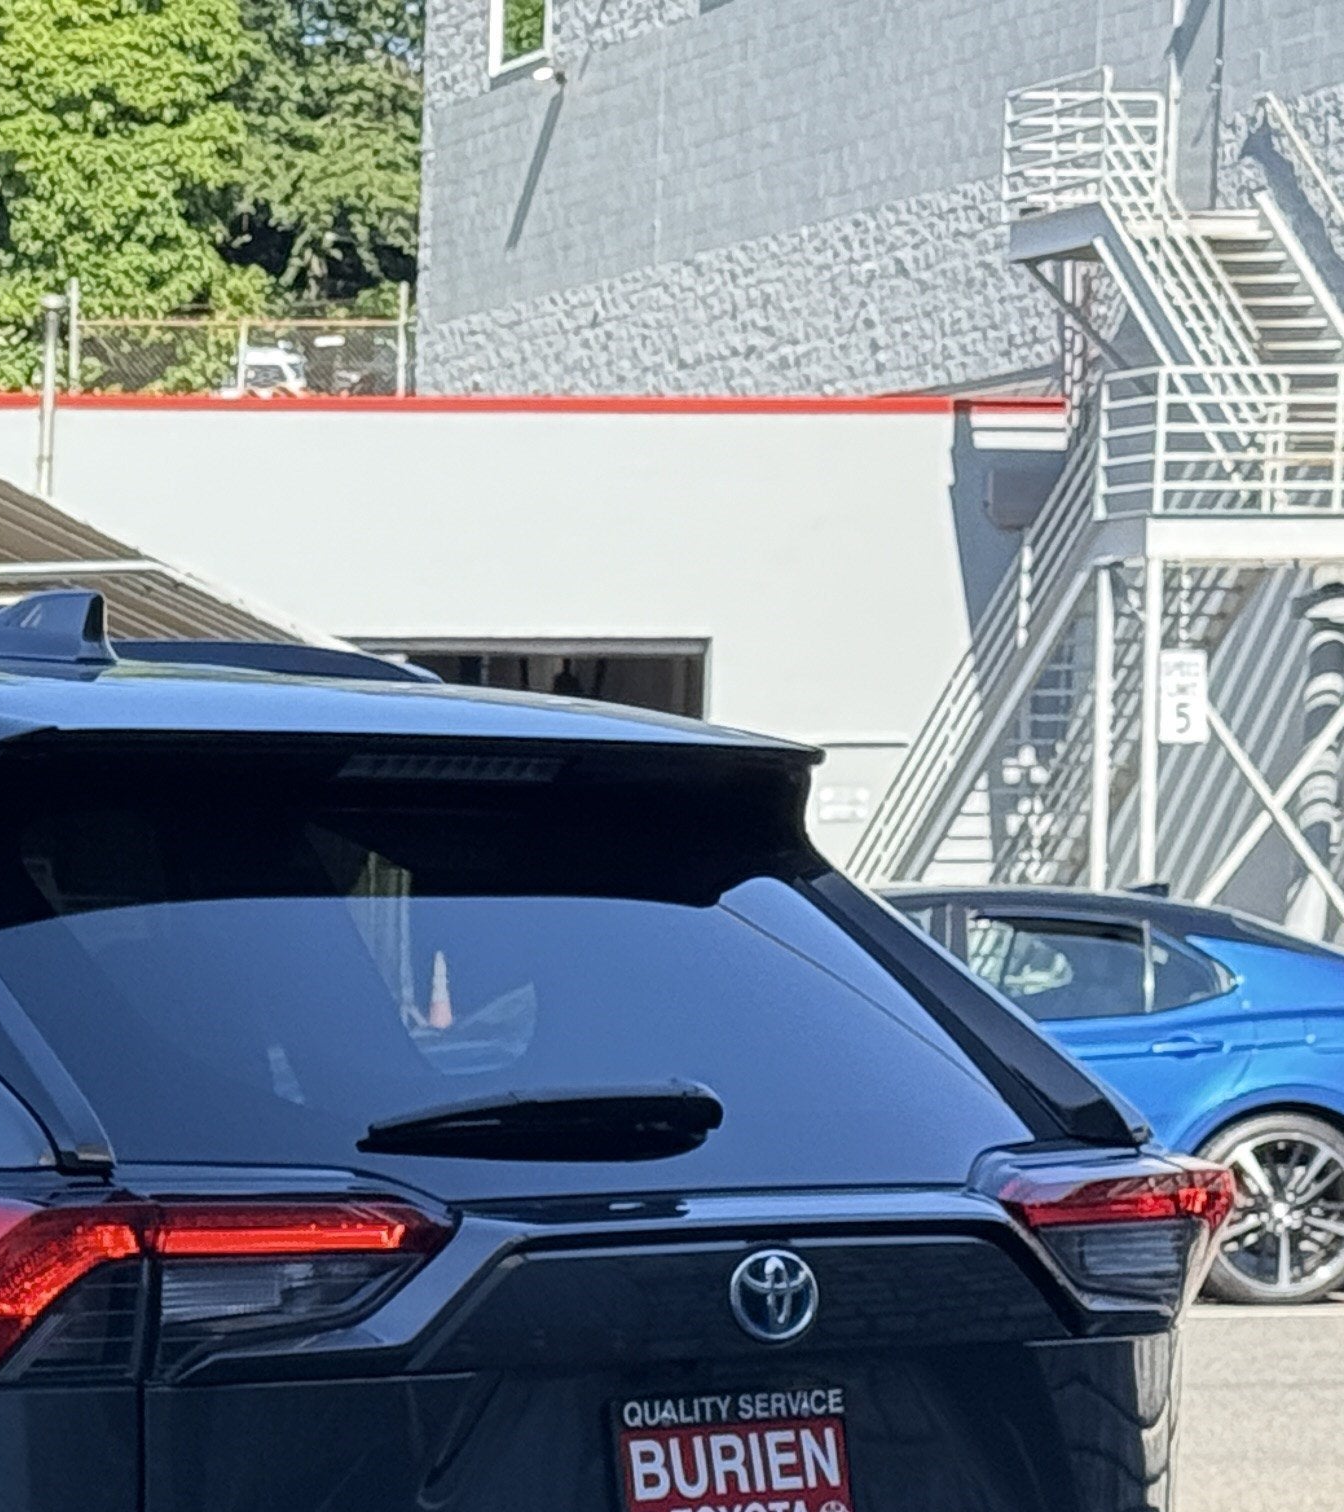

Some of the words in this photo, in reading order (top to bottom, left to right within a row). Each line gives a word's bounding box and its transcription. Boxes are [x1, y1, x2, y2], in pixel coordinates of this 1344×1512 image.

[1176, 702, 1190, 734] 5
[623, 1395, 732, 1428] QUALITY
[738, 1388, 845, 1420] SERVICE
[628, 1427, 841, 1501] BURIEN
